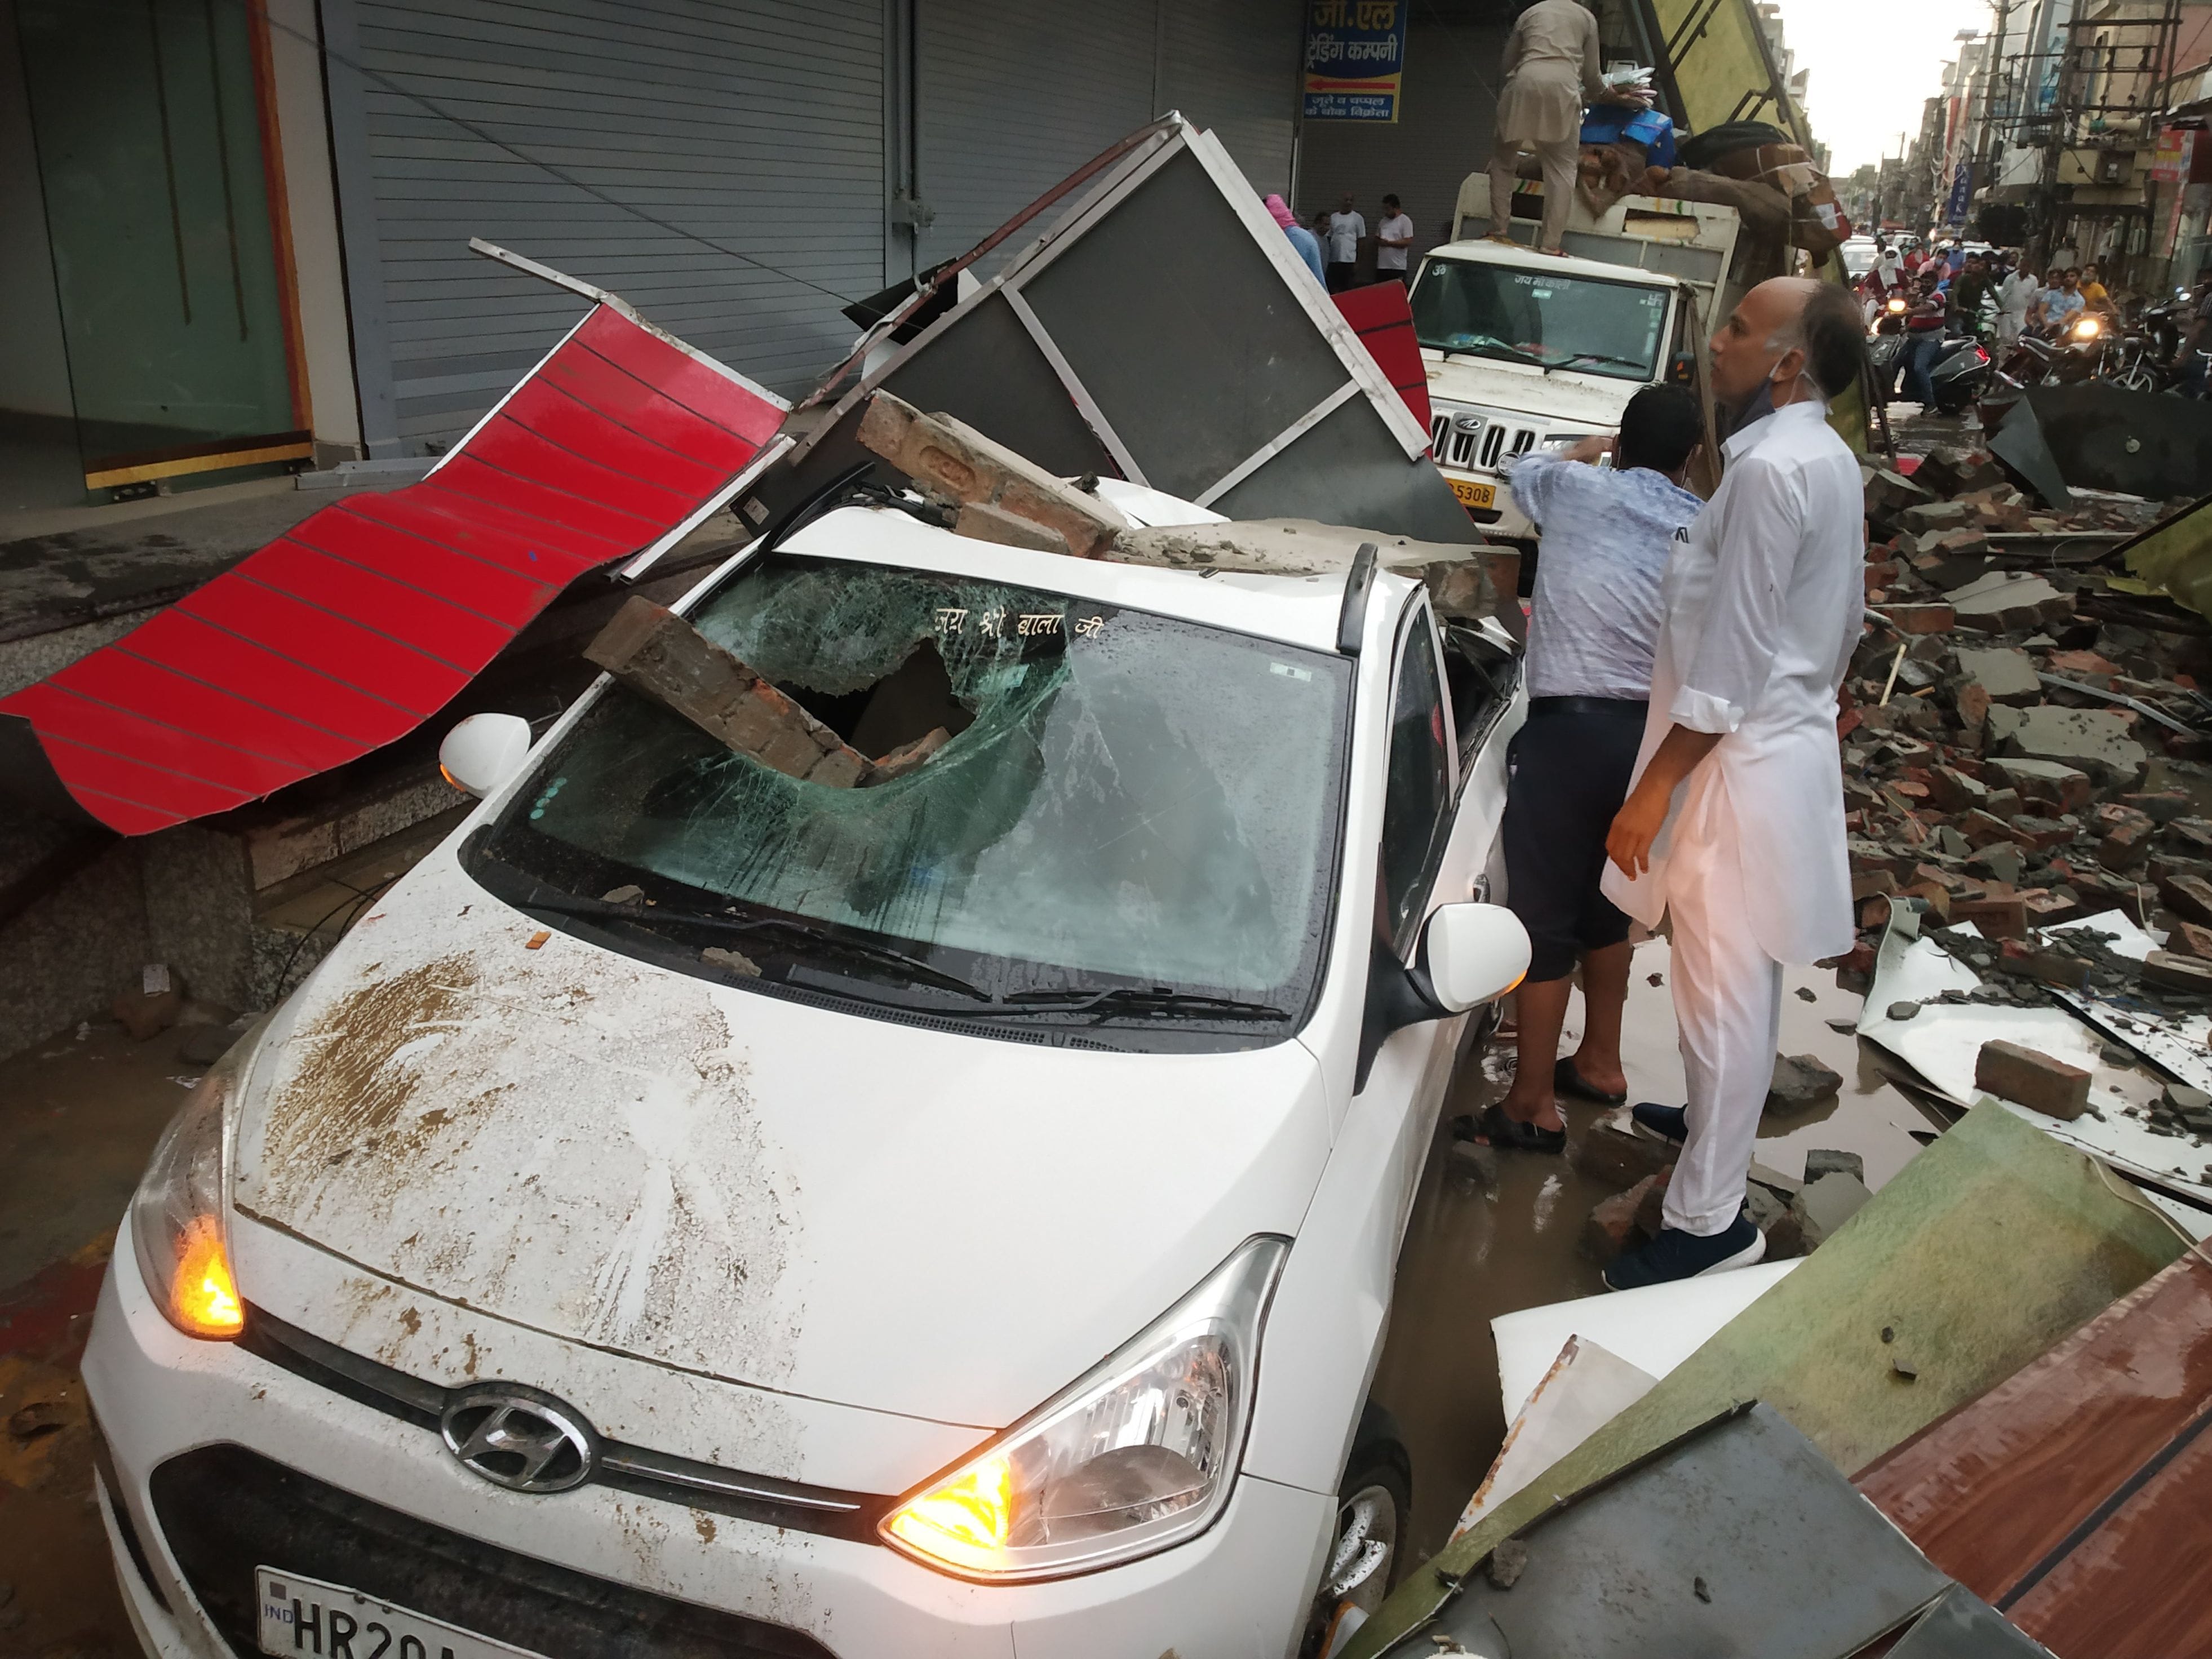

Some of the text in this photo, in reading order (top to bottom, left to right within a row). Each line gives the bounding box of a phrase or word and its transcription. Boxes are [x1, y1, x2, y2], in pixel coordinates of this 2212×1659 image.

[1348, 33, 1398, 61] कम्पनी
[1514, 274, 1533, 285] जय
[1449, 482, 1491, 503] 5308
[1017, 613, 1065, 636] बाला
[1074, 616, 1105, 639] जी
[264, 1604, 295, 1624] IND
[292, 1598, 455, 1659] HR2
